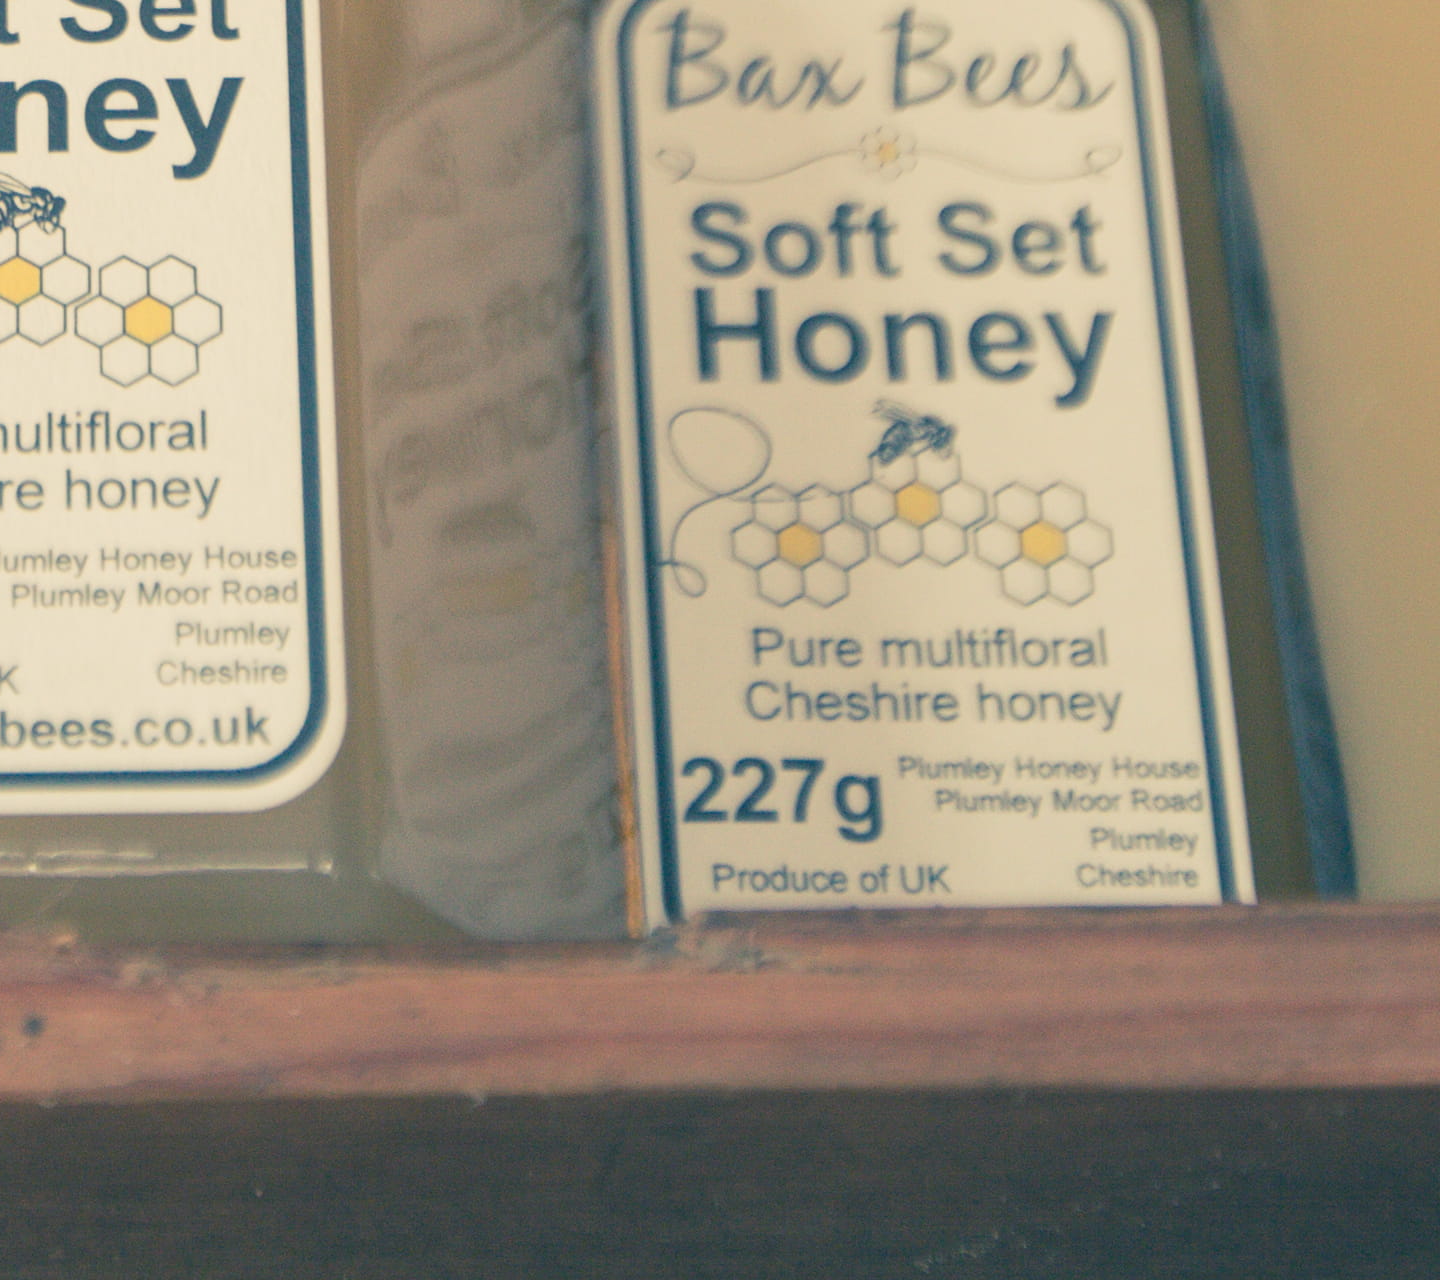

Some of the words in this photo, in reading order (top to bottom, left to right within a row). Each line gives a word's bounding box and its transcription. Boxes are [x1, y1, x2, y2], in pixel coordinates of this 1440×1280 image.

[653, 10, 865, 113] Bax
[881, 6, 1115, 109] Bees
[689, 200, 898, 278] Soft
[936, 200, 1104, 278] Set
[691, 285, 1111, 409] Honey
[65, 468, 220, 519] honey
[99, 547, 192, 575] Honey
[204, 546, 298, 568] House
[11, 582, 125, 611] Plumley
[137, 580, 210, 604] Moor
[221, 579, 299, 603] Road
[175, 620, 290, 649] Plumley
[750, 626, 862, 668] Pure
[877, 627, 1106, 669] multifloral
[157, 660, 287, 684] Cheshire
[744, 679, 958, 722] Cheshire
[975, 682, 1122, 732] honey
[896, 754, 1003, 783] Plumley
[1014, 757, 1101, 784] Honey
[1111, 753, 1200, 780] House
[681, 756, 883, 843] 227g
[933, 787, 1041, 817] Plumley
[1051, 789, 1120, 812] Moor
[1127, 786, 1205, 814] Road
[1089, 826, 1198, 856] Plumley
[711, 862, 848, 894] Produce
[859, 864, 890, 895] of
[899, 865, 949, 895] UK
[1076, 863, 1198, 888] Cheshire
